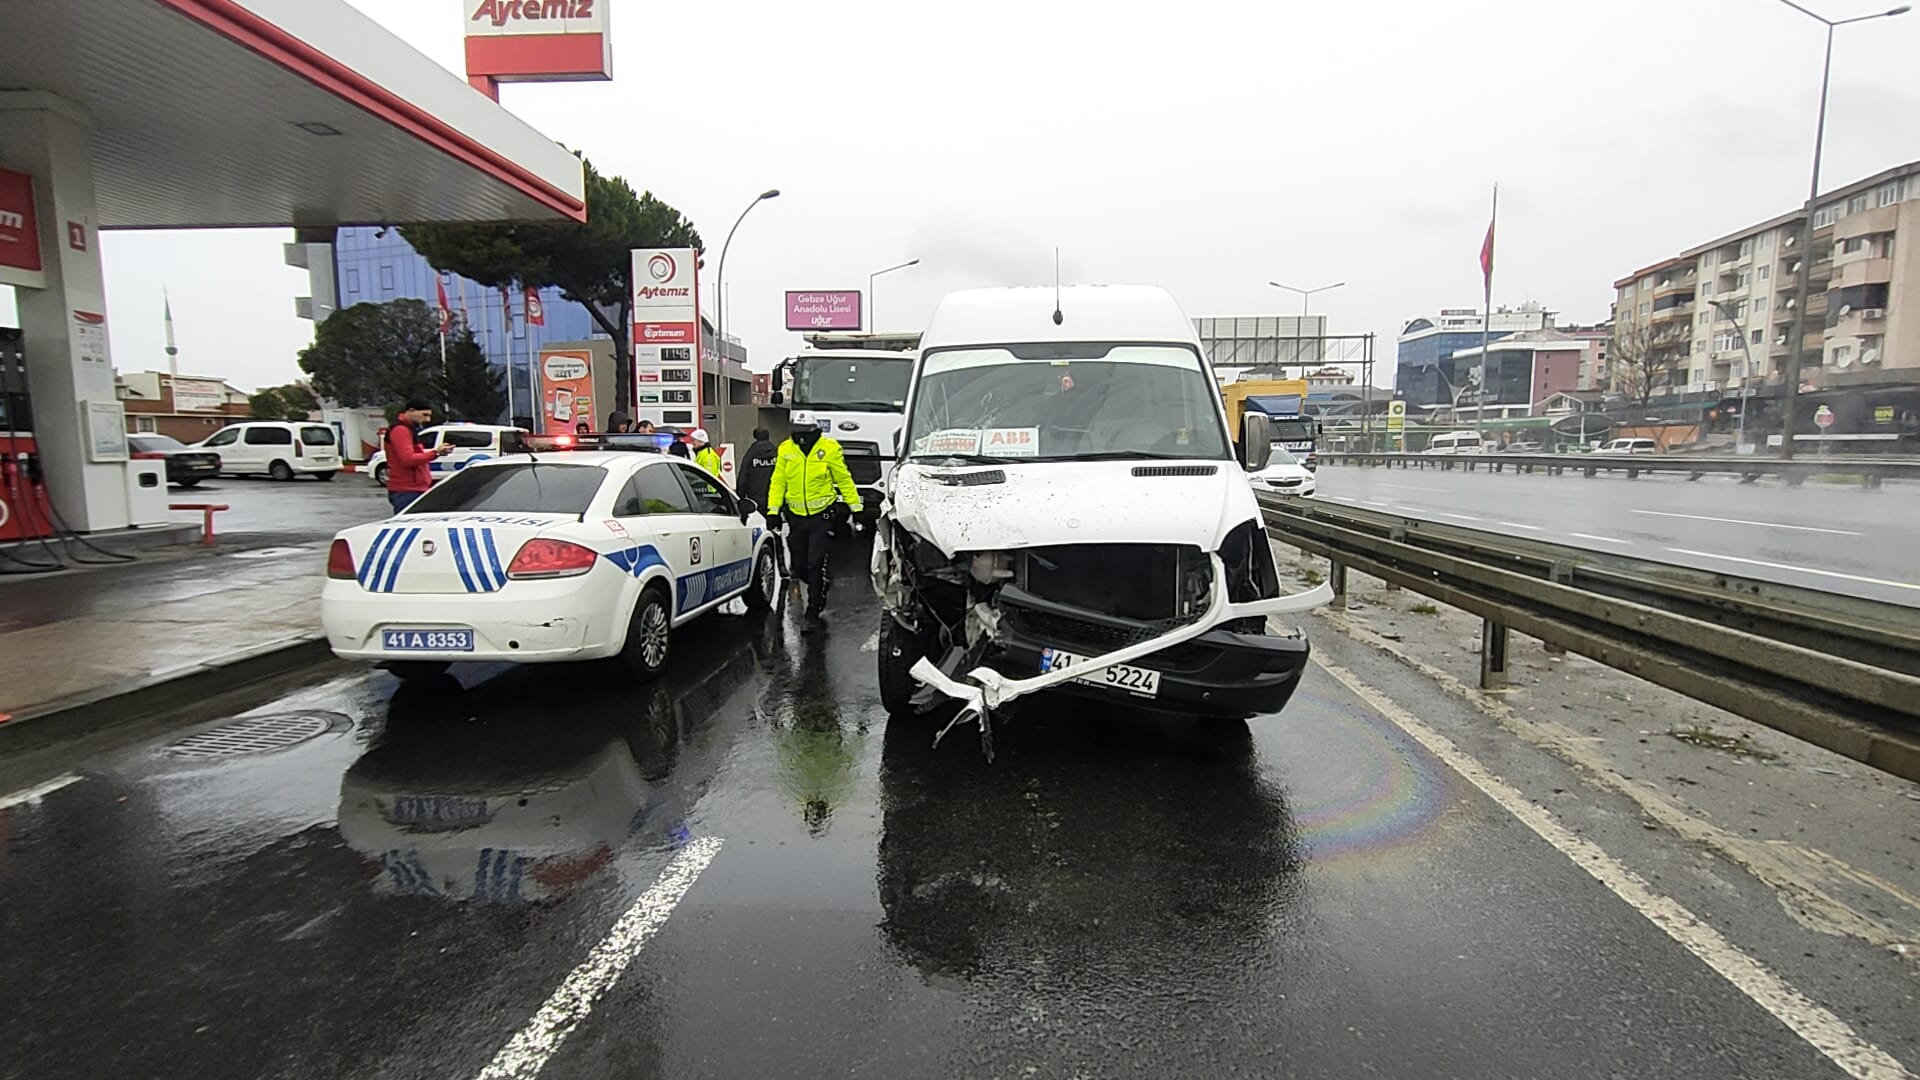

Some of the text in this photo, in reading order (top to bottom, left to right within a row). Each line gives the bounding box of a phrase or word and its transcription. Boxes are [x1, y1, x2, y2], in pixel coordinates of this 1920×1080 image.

[797, 293, 847, 304] Gebze Uğur
[793, 304, 851, 313] Anadolu Lisesi
[811, 315, 833, 327] uğur
[990, 431, 1031, 445] ABB
[388, 633, 467, 647] 41 A 8353
[1052, 653, 1072, 670] 41
[1105, 664, 1153, 690] 5224
